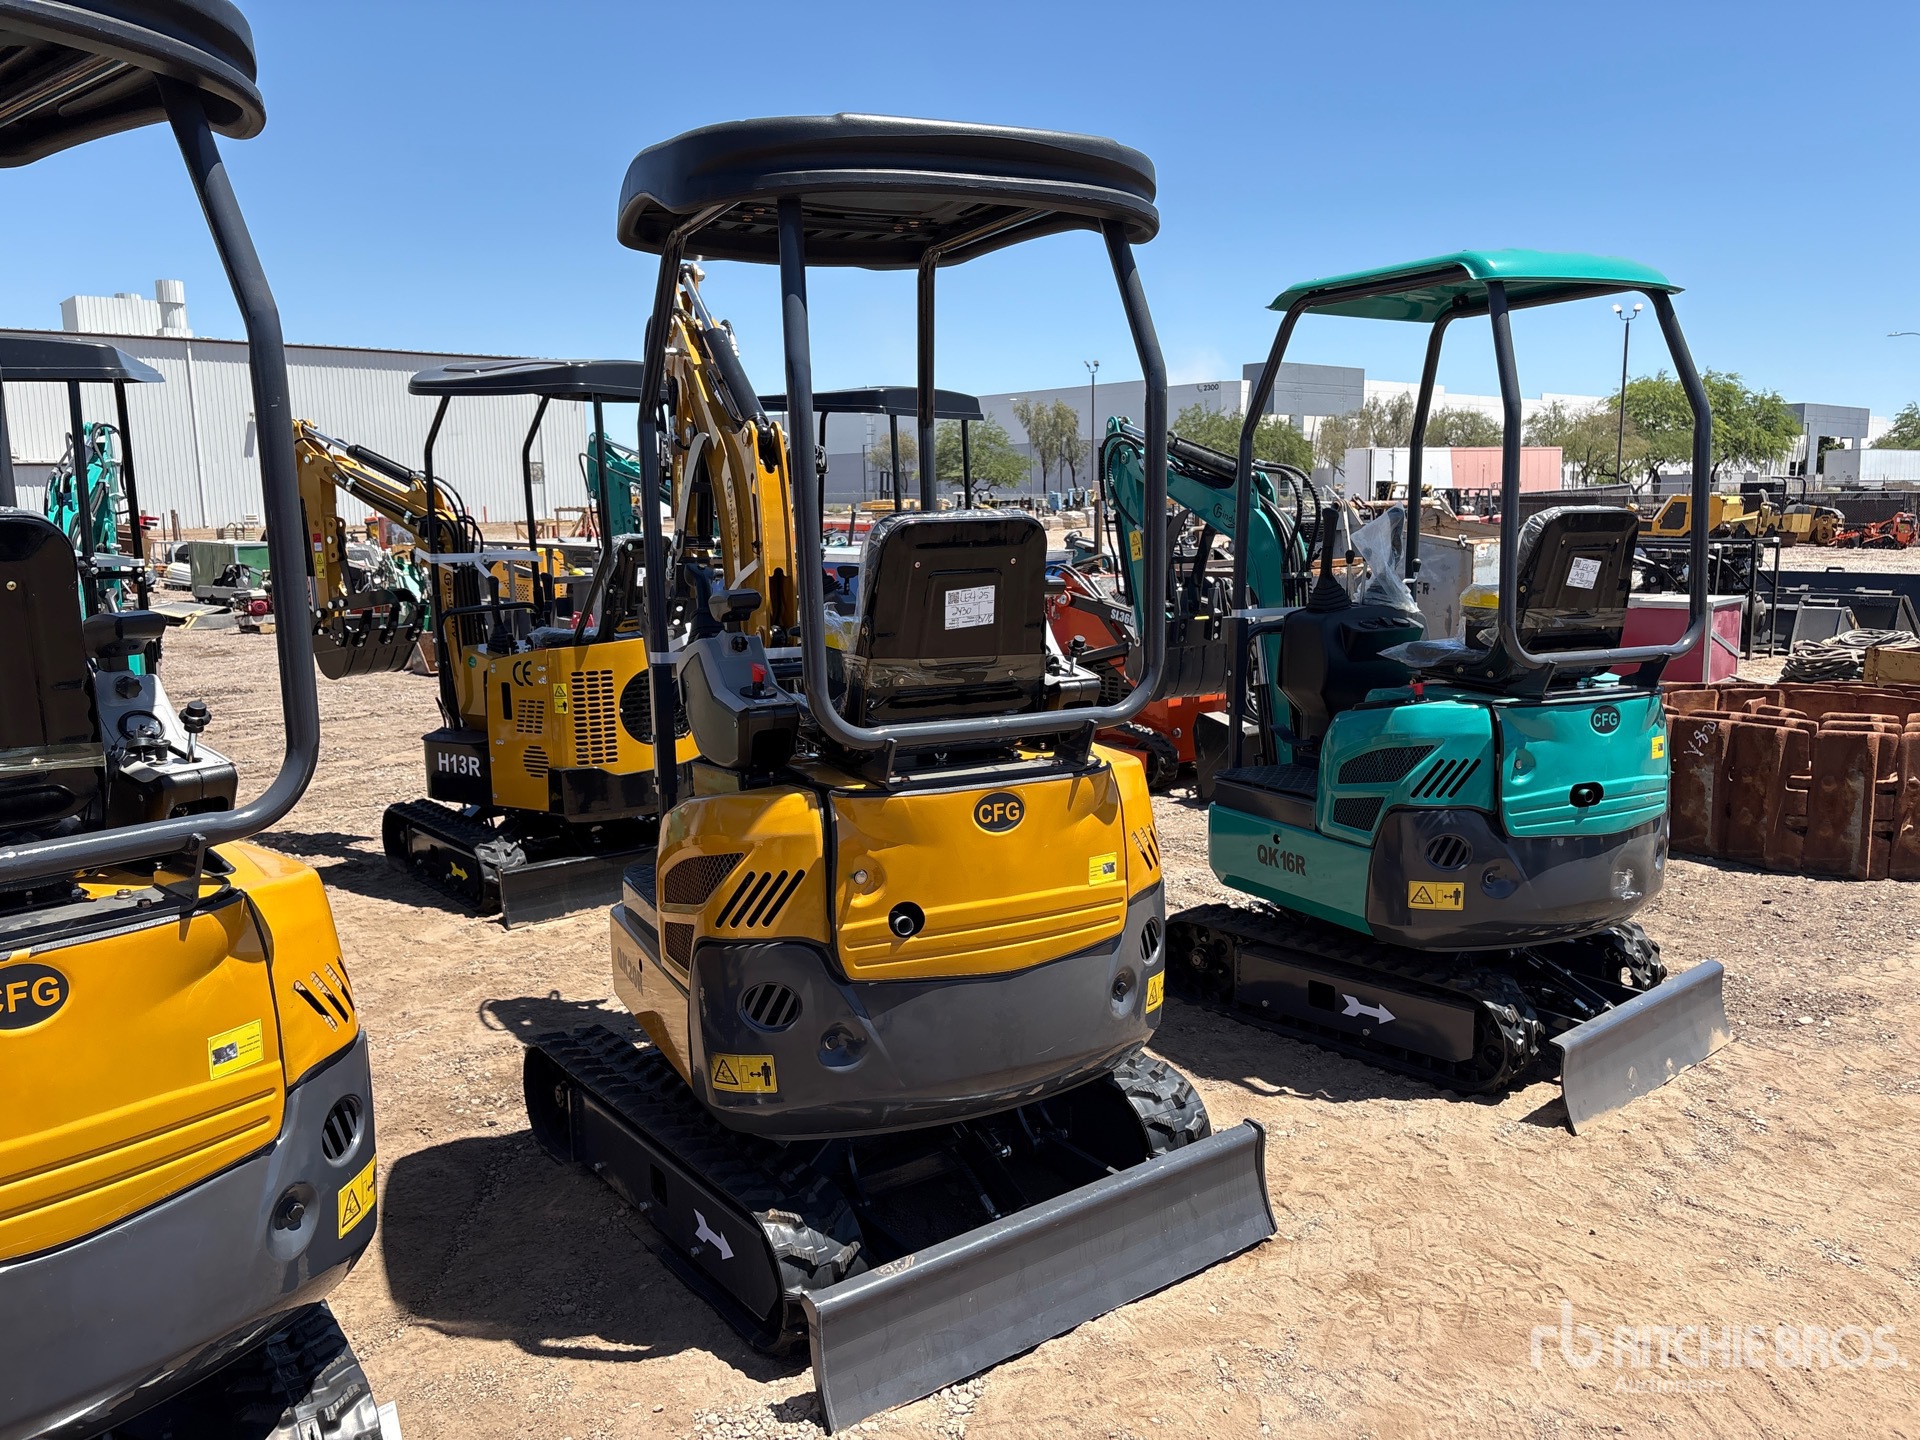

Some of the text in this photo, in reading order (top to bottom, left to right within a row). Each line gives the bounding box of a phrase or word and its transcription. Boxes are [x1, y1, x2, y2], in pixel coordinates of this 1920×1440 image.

[1203, 383, 1220, 392] 2300
[512, 660, 534, 687] CE
[1593, 712, 1618, 727] CFG
[438, 751, 481, 777] H13R
[978, 801, 1020, 824] CFG
[0, 976, 61, 1014] FG
